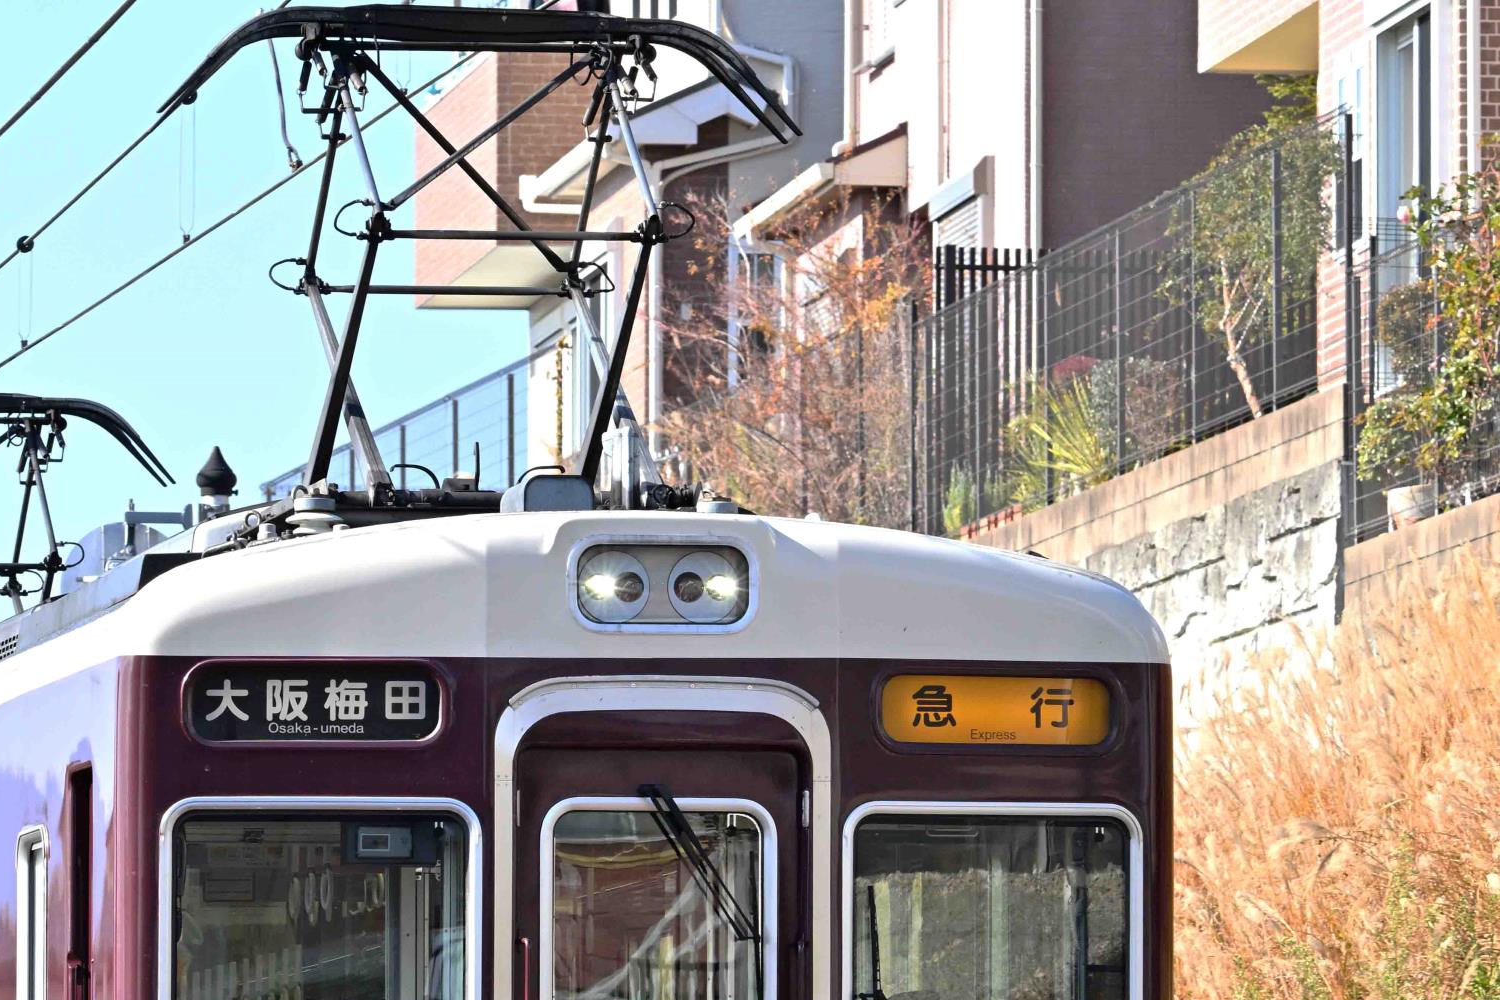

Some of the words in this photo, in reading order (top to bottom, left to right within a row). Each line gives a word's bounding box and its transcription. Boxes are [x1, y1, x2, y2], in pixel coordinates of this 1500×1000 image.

[205, 679, 426, 722] 大阪梅田
[912, 685, 1075, 729] 急行
[970, 728, 1017, 742] Express
